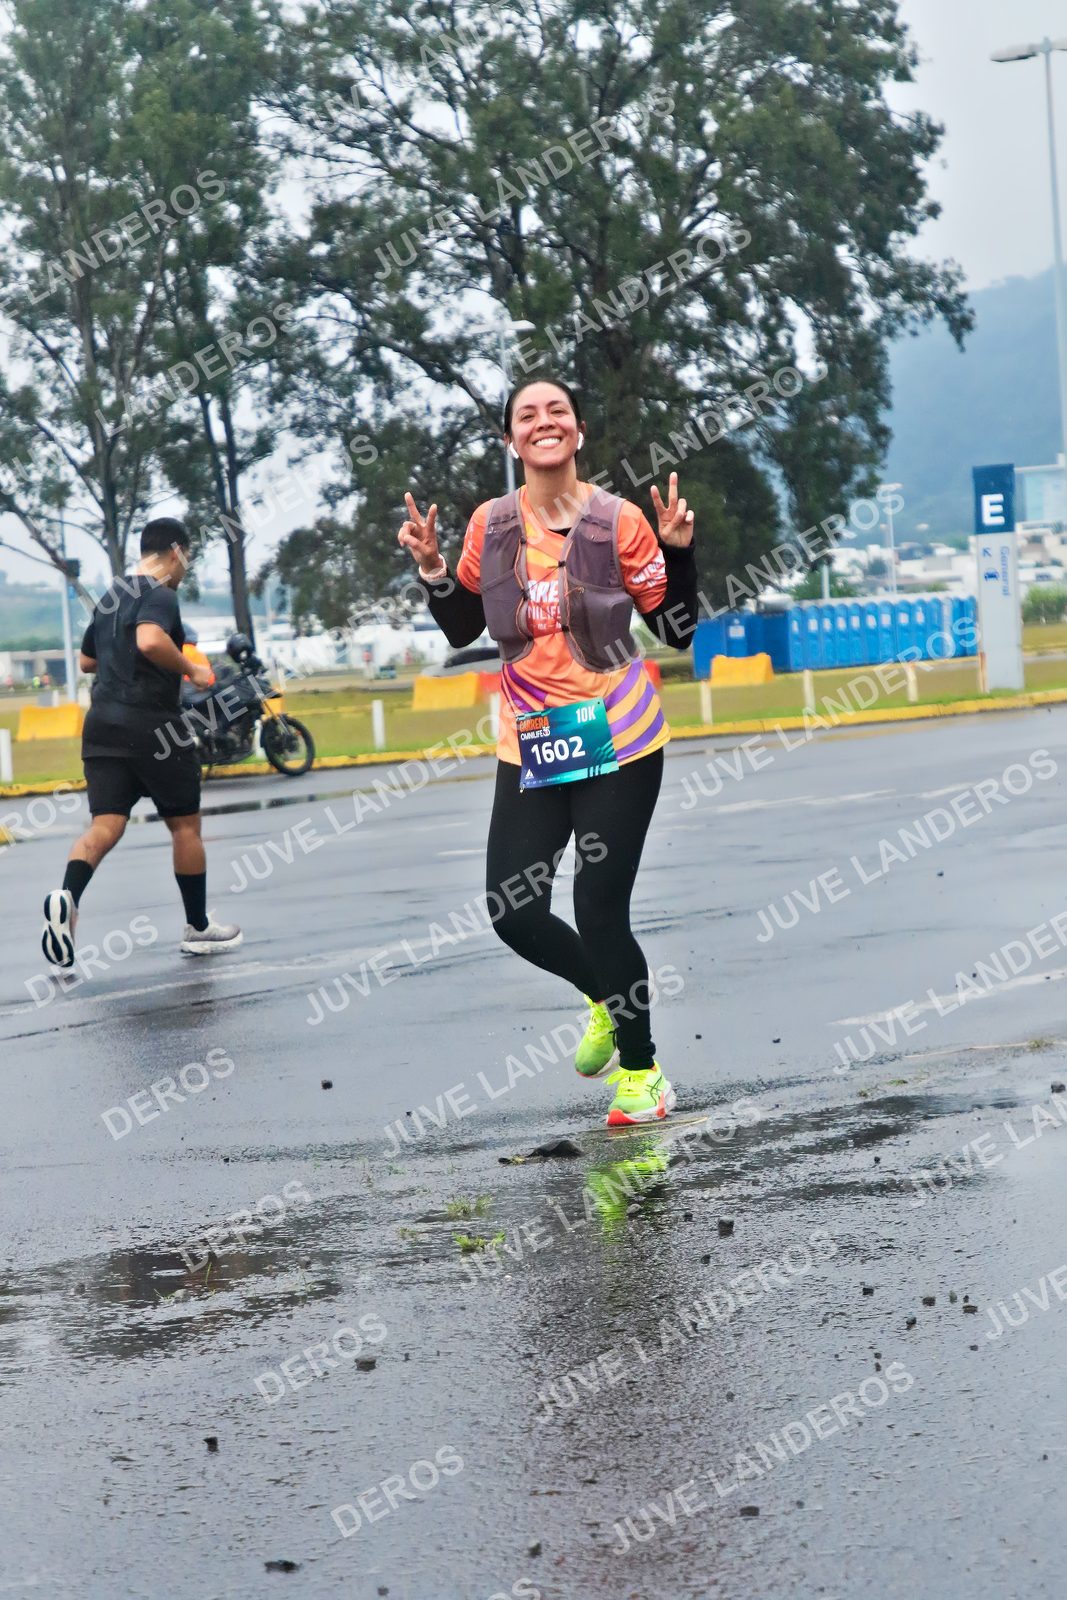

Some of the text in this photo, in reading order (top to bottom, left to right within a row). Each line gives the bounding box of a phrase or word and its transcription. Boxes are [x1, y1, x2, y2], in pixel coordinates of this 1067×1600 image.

[981, 493, 1006, 526] E
[1001, 546, 1011, 597] General
[576, 705, 597, 724] 10K
[531, 736, 586, 765] 1602
